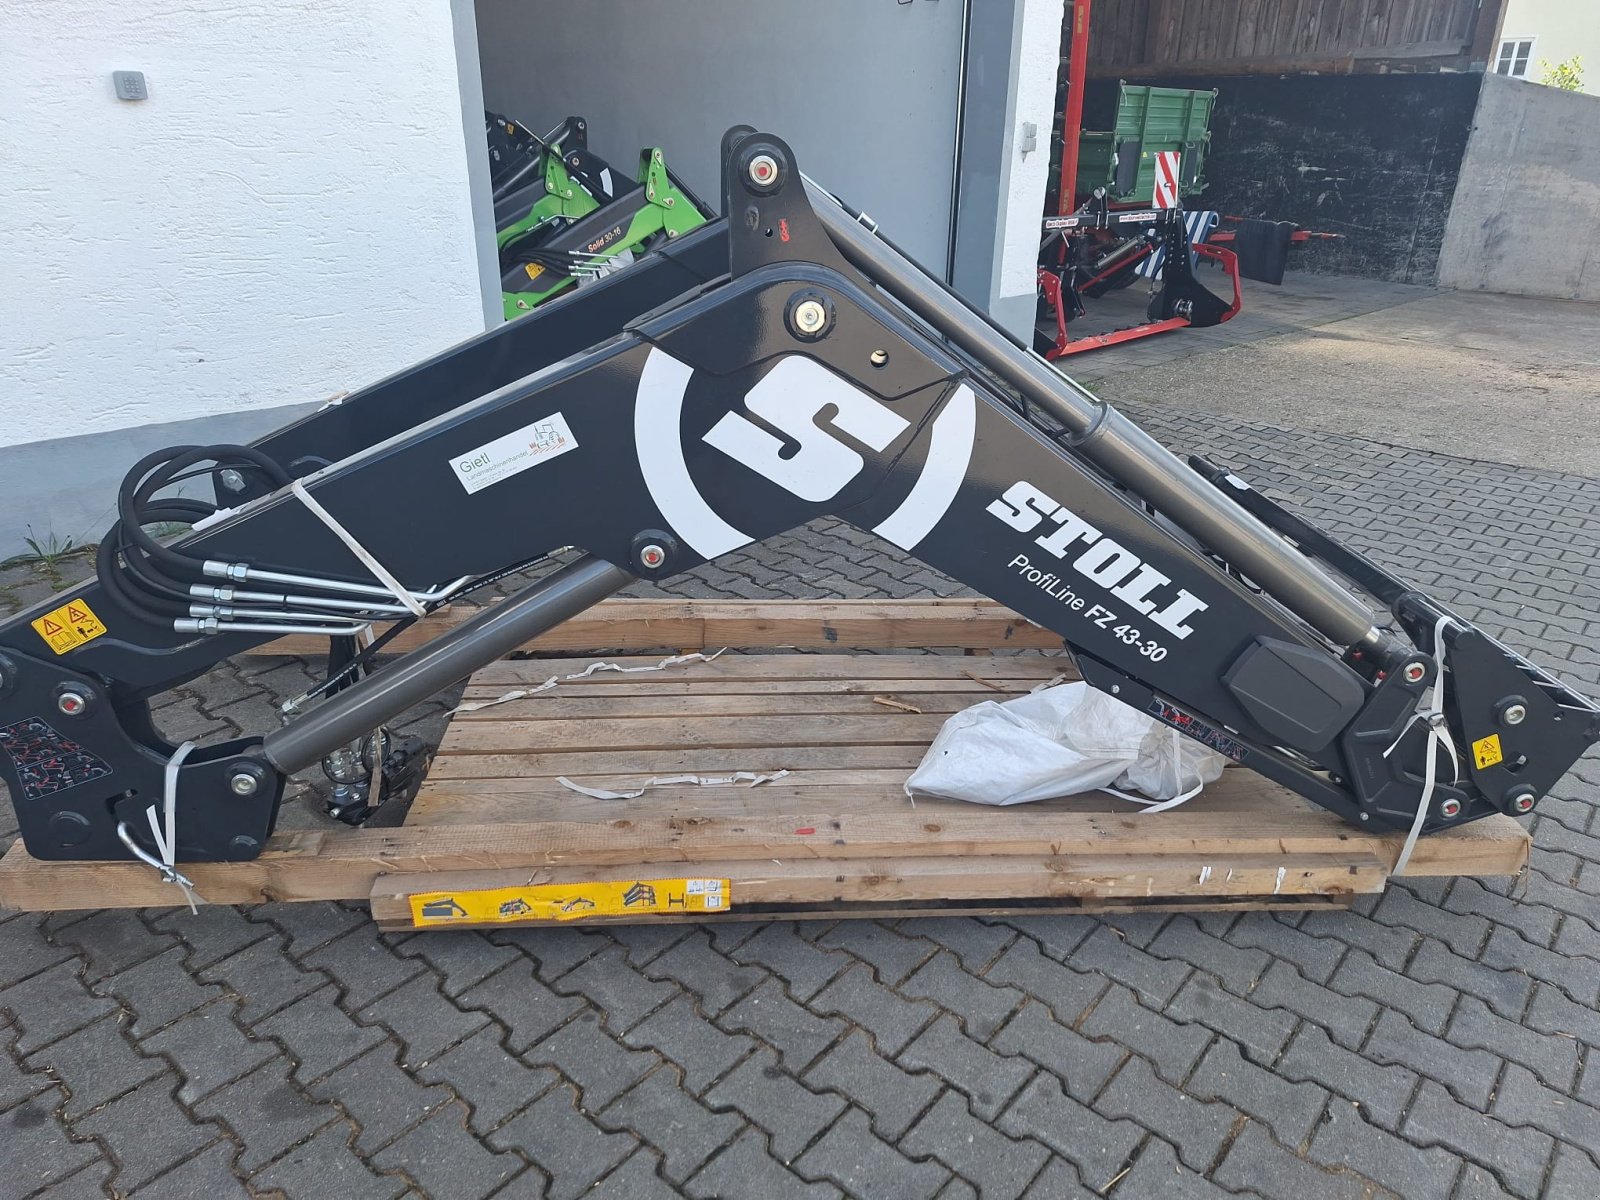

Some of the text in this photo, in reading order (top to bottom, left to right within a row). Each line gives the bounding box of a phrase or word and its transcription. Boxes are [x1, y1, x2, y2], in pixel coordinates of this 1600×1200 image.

[588, 236, 605, 253] Solid
[459, 452, 491, 473] Gietl
[466, 450, 529, 482] Landmaschinenhandel
[985, 480, 1209, 640] STOLL
[1007, 553, 1168, 662] ProfiLine FZ 43-30
